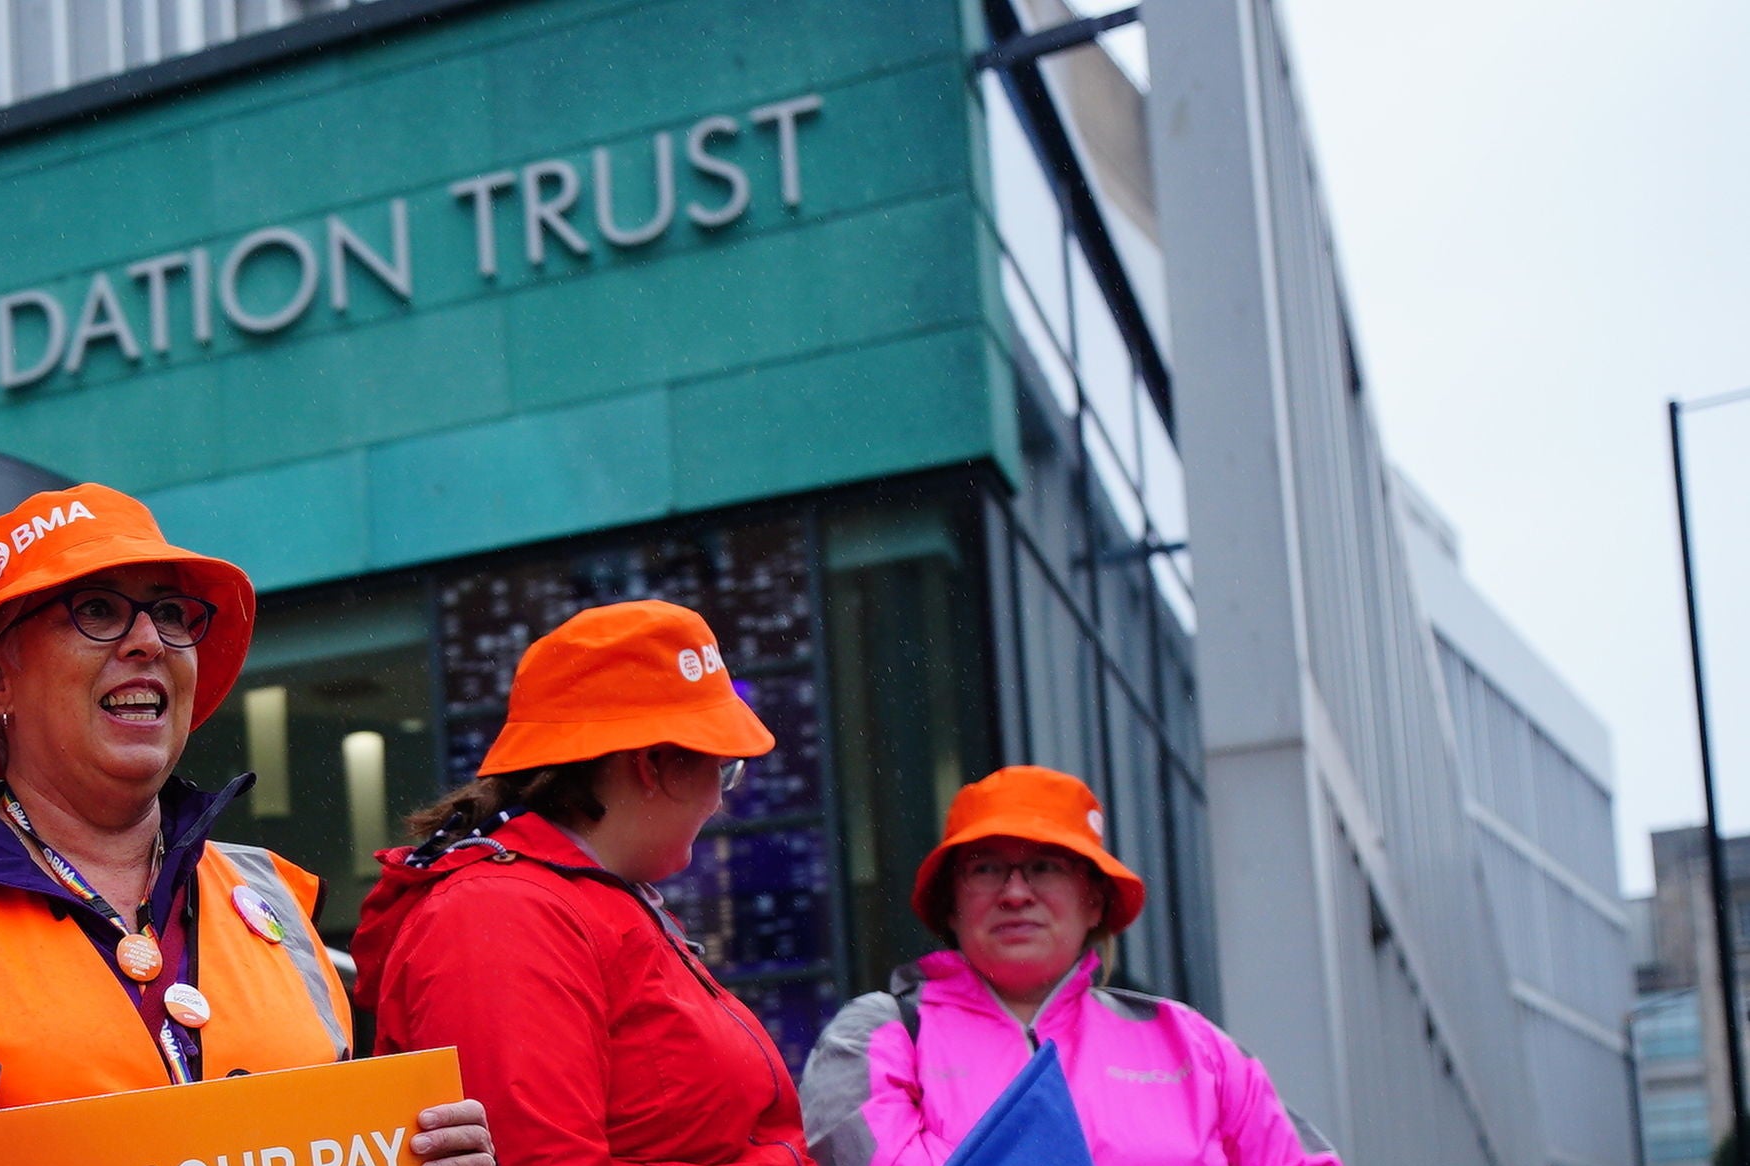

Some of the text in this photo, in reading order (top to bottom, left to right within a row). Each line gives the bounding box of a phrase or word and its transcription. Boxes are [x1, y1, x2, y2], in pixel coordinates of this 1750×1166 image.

[453, 95, 824, 281] TRUST
[10, 500, 97, 554] BMA
[50, 855, 75, 884] BMA
